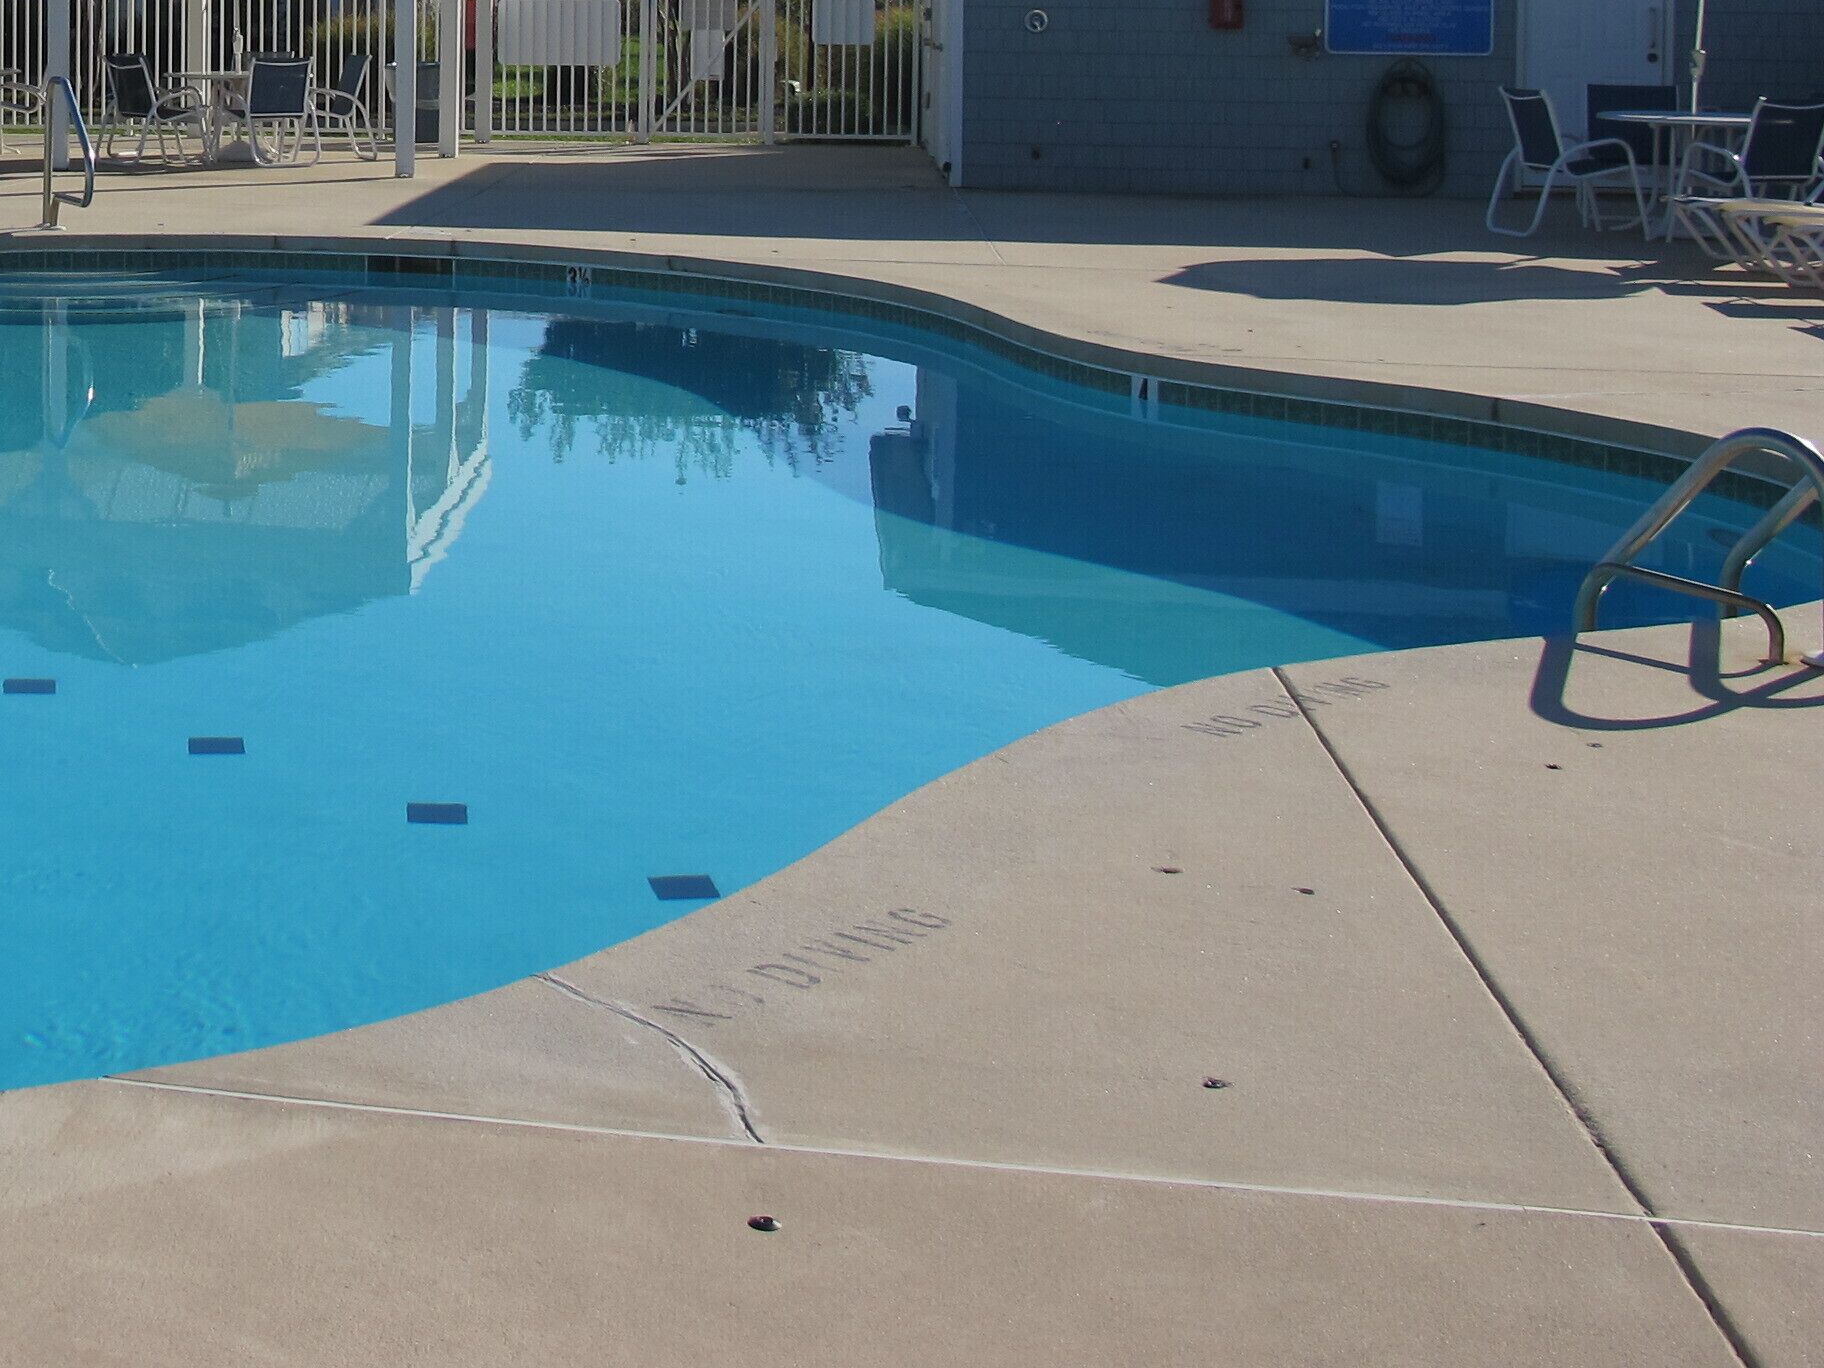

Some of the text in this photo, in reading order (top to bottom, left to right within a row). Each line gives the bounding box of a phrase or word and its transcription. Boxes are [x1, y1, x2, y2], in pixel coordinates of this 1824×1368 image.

[1179, 676, 1391, 738] NO DIVING
[746, 907, 952, 990] DIVING
